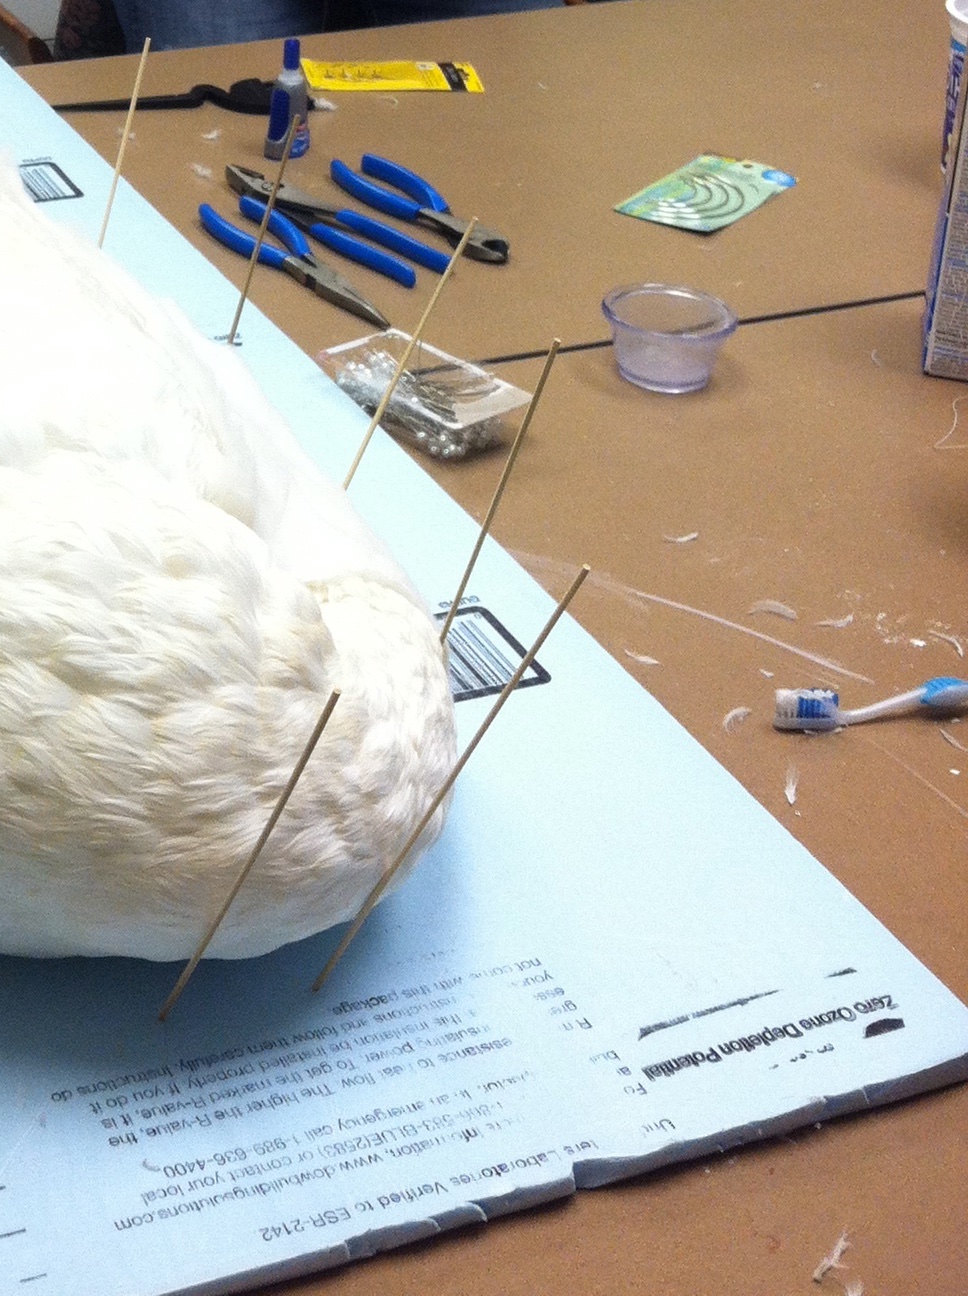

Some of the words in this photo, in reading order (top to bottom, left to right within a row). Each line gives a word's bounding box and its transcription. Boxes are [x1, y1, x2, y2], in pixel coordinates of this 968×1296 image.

[402, 984, 431, 999] this
[433, 975, 463, 989] with
[799, 1006, 856, 1030] Ozone
[854, 995, 898, 1022] Zero
[286, 1025, 337, 1048] follow
[329, 1039, 352, 1053] be
[718, 1023, 802, 1059] Depletion
[257, 1044, 328, 1072] installed
[336, 1058, 356, 1072] To
[641, 1049, 722, 1081] Potential
[274, 1071, 302, 1087] the
[305, 1061, 333, 1077] get
[76, 1065, 173, 1097] Instructions
[209, 1078, 272, 1102] marked
[301, 1083, 336, 1100] The
[51, 1089, 73, 1102] do
[105, 1095, 128, 1109] do
[133, 1083, 166, 1102] you
[246, 1090, 300, 1114] higher
[88, 1102, 102, 1115] it
[135, 1096, 206, 1120] R-value,
[214, 1107, 244, 1122] the
[100, 1116, 116, 1130] is
[120, 1113, 134, 1127] it
[139, 1113, 212, 1139] R-value,
[108, 1131, 138, 1149] the
[304, 1125, 333, 1141] call
[229, 1156, 292, 1181] contact
[450, 1150, 560, 1186] Laboratories
[187, 1171, 223, 1192] your
[141, 1184, 184, 1206] local
[378, 1181, 448, 1210] Verified
[259, 1207, 350, 1241] ESR-2142
